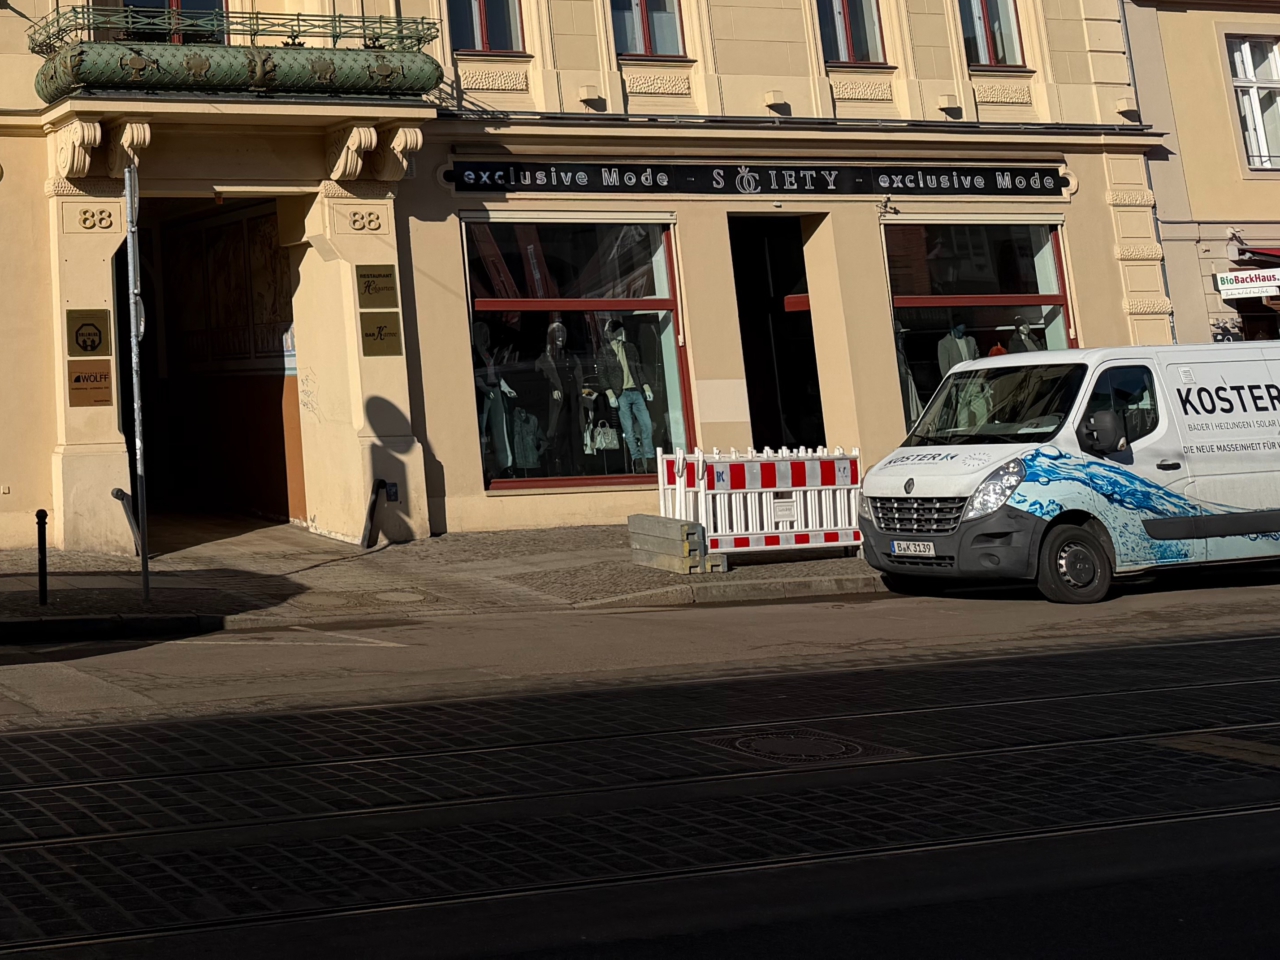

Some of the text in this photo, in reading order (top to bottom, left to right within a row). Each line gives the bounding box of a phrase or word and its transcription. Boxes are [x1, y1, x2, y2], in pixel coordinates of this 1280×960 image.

[463, 166, 589, 185] exclusive
[602, 168, 669, 186] Mode
[878, 171, 985, 188] exclusive
[996, 172, 1054, 189] Mode
[78, 208, 113, 230] 88
[349, 210, 381, 231] 88
[81, 375, 109, 383] WOLFF
[1176, 384, 1280, 416] KOSTER
[1188, 419, 1276, 431] BÄDER HEIZUNGEN SOLAR
[1183, 440, 1277, 454] DIE NEUE MASSEINHEIT FÜR
[912, 543, 931, 553] 3139
